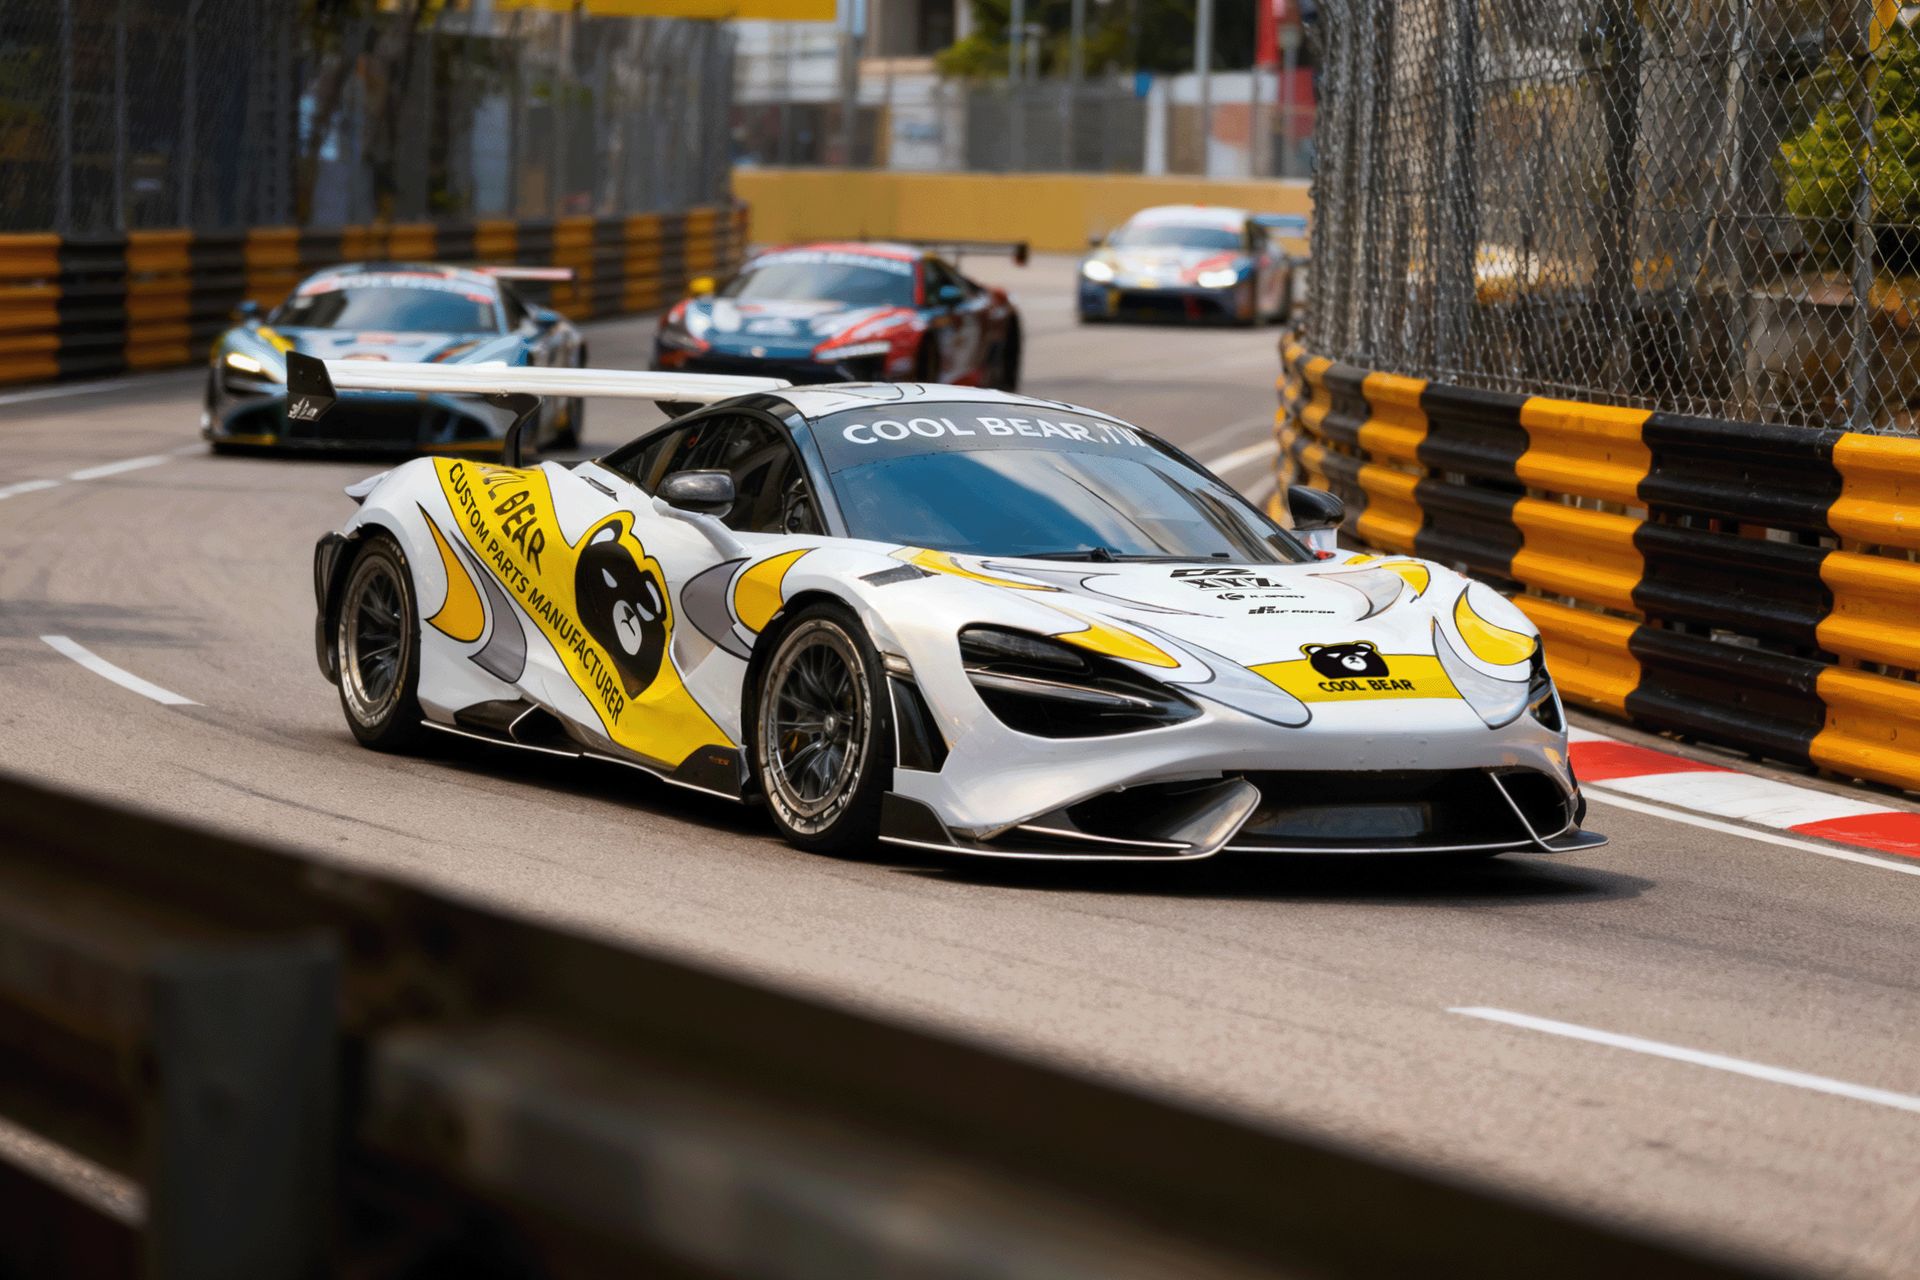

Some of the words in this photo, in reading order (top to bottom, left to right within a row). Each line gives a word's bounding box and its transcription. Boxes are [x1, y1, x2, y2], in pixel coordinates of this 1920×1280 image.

[842, 417, 975, 445] COOL
[494, 490, 545, 576] BEAR
[449, 462, 490, 543] CUSTOM
[486, 536, 530, 594] PARTS
[527, 588, 625, 726] MANUFACTURER
[1318, 680, 1367, 693] COOL
[1366, 679, 1416, 692] BEAR
